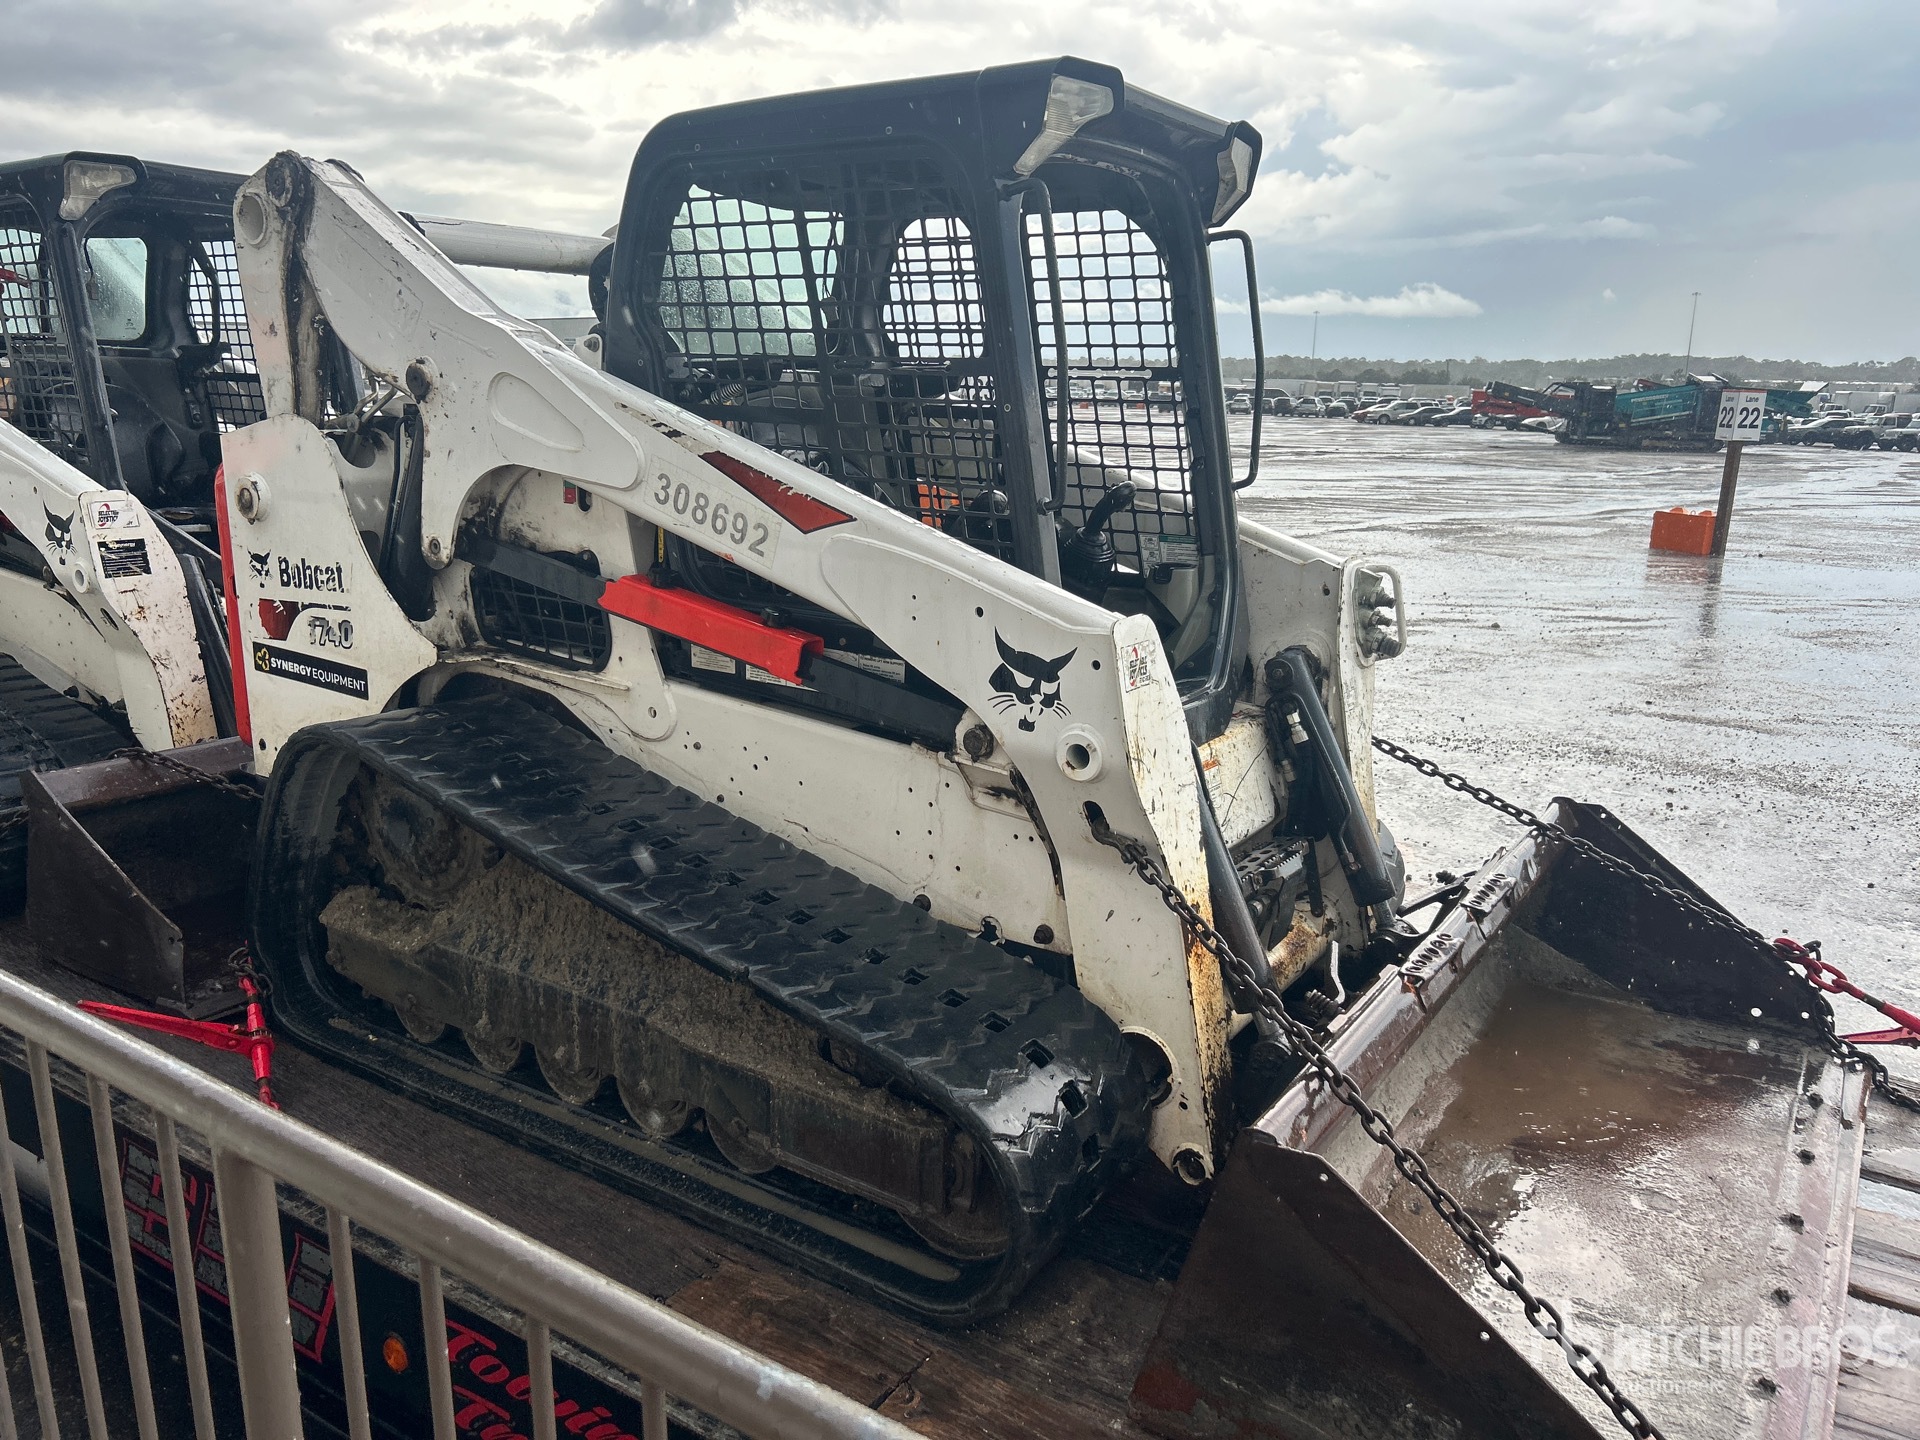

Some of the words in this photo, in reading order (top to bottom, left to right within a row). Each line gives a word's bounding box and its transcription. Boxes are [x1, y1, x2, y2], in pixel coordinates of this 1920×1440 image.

[1745, 395, 1759, 403] Lane
[1718, 406, 1734, 428] 22
[1737, 406, 1760, 429] 22
[654, 473, 769, 557] 308692
[277, 556, 345, 593] Bobcat
